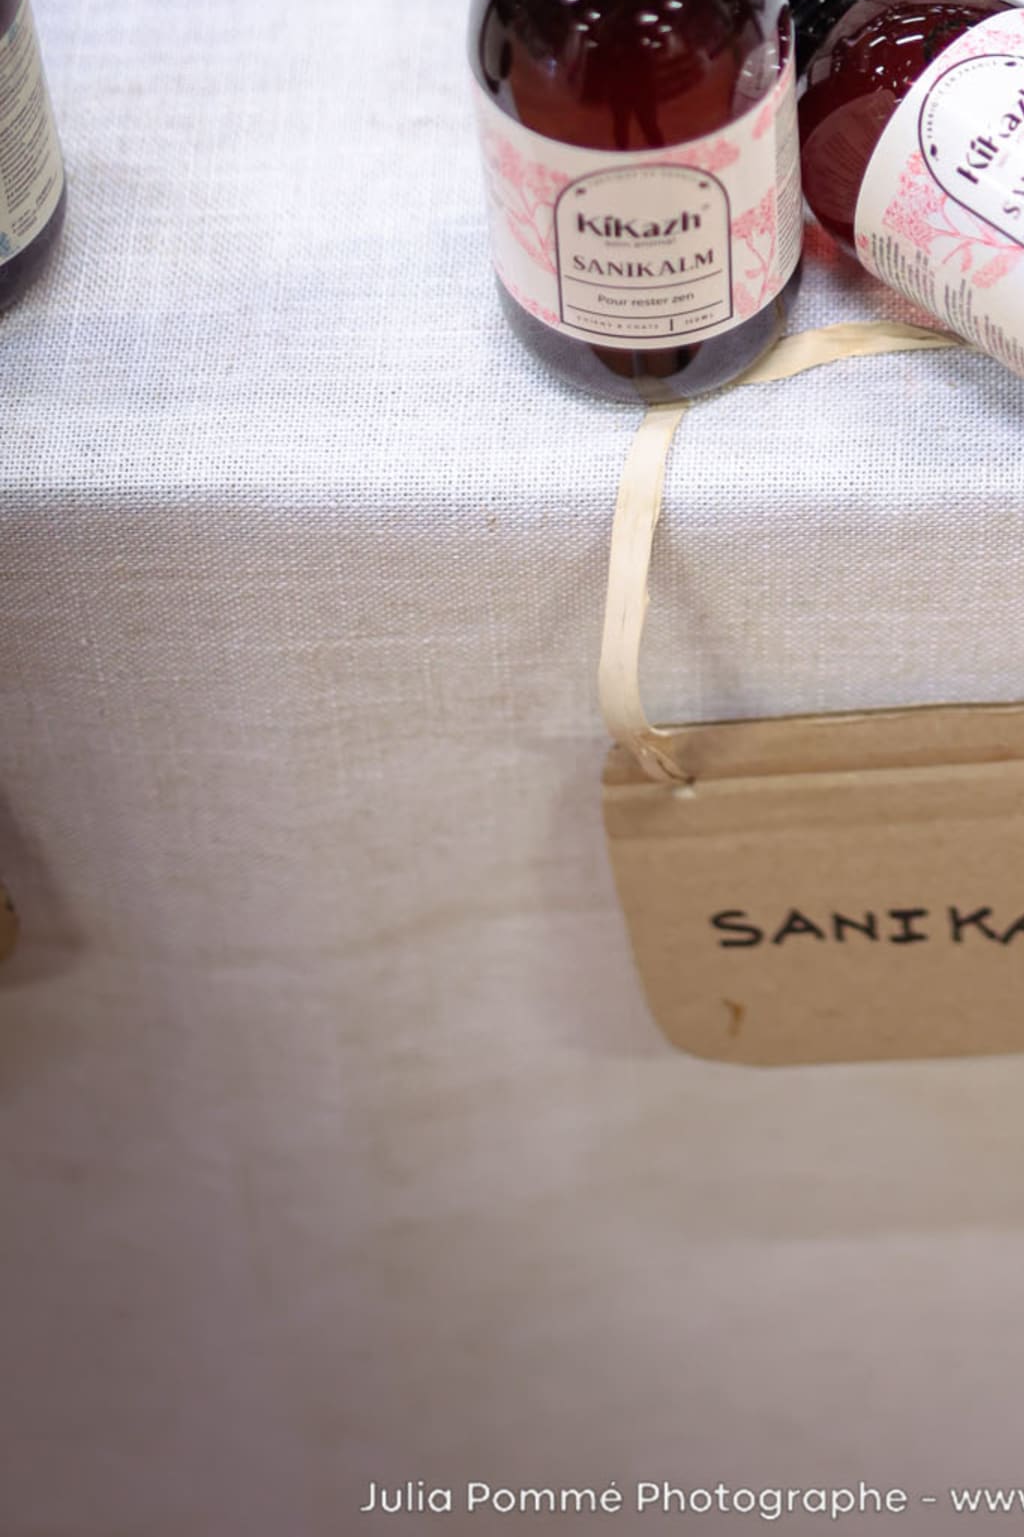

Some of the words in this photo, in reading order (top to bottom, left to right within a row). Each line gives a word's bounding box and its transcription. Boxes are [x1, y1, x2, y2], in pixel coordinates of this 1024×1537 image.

[572, 248, 715, 278] SANIKALM
[597, 293, 628, 307] Pour
[631, 297, 670, 307] rester
[671, 292, 695, 304] zen
